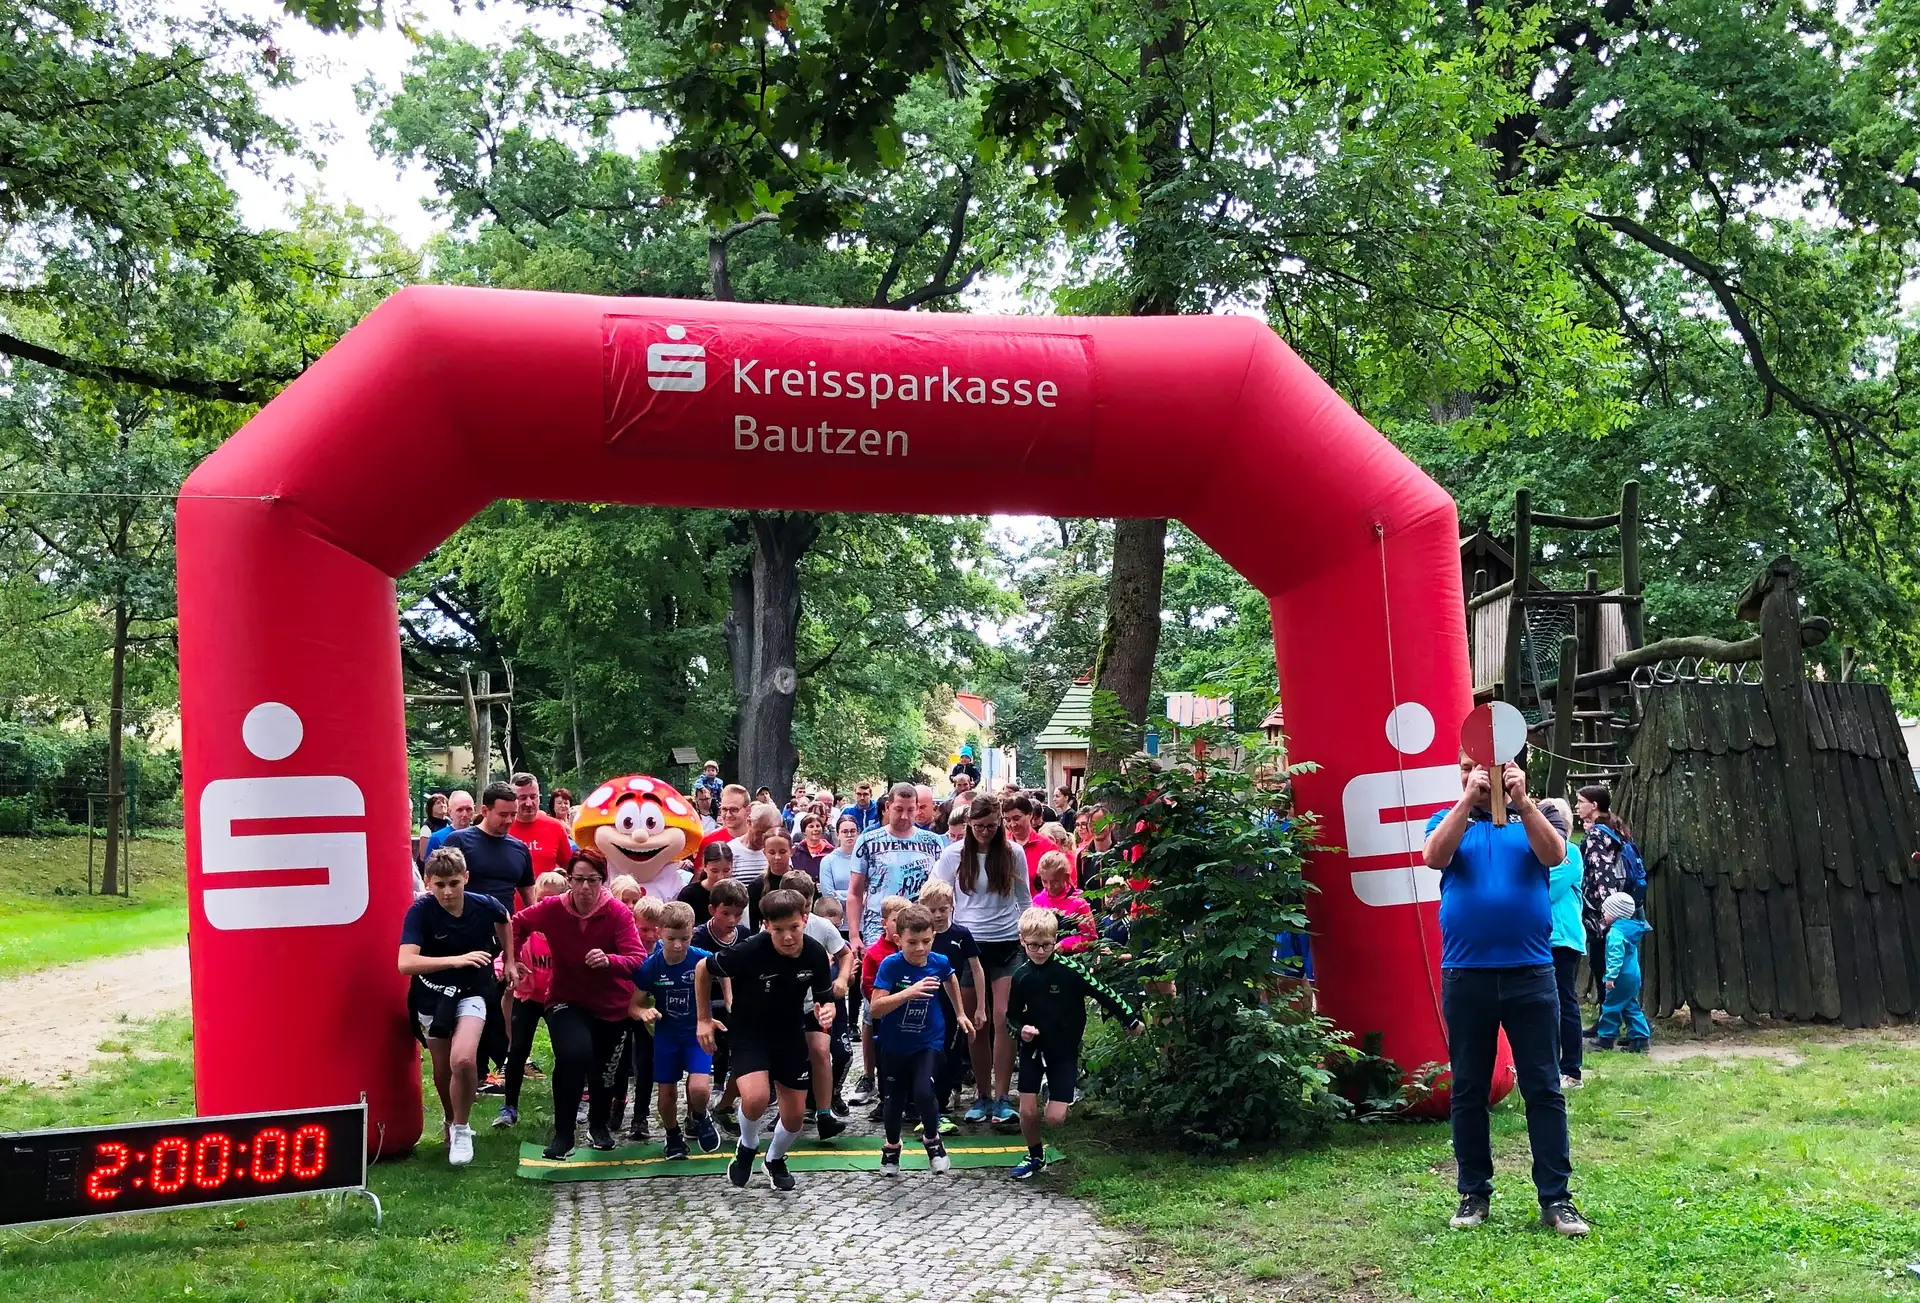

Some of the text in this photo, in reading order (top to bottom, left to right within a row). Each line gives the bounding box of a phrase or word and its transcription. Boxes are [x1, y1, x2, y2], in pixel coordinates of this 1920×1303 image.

[733, 359, 1059, 409] Kreissparkasse
[734, 415, 910, 457] Bautzen
[669, 996, 686, 1005] PTH
[907, 1008, 925, 1016] PTH
[86, 1124, 329, 1201] 2:00:00
